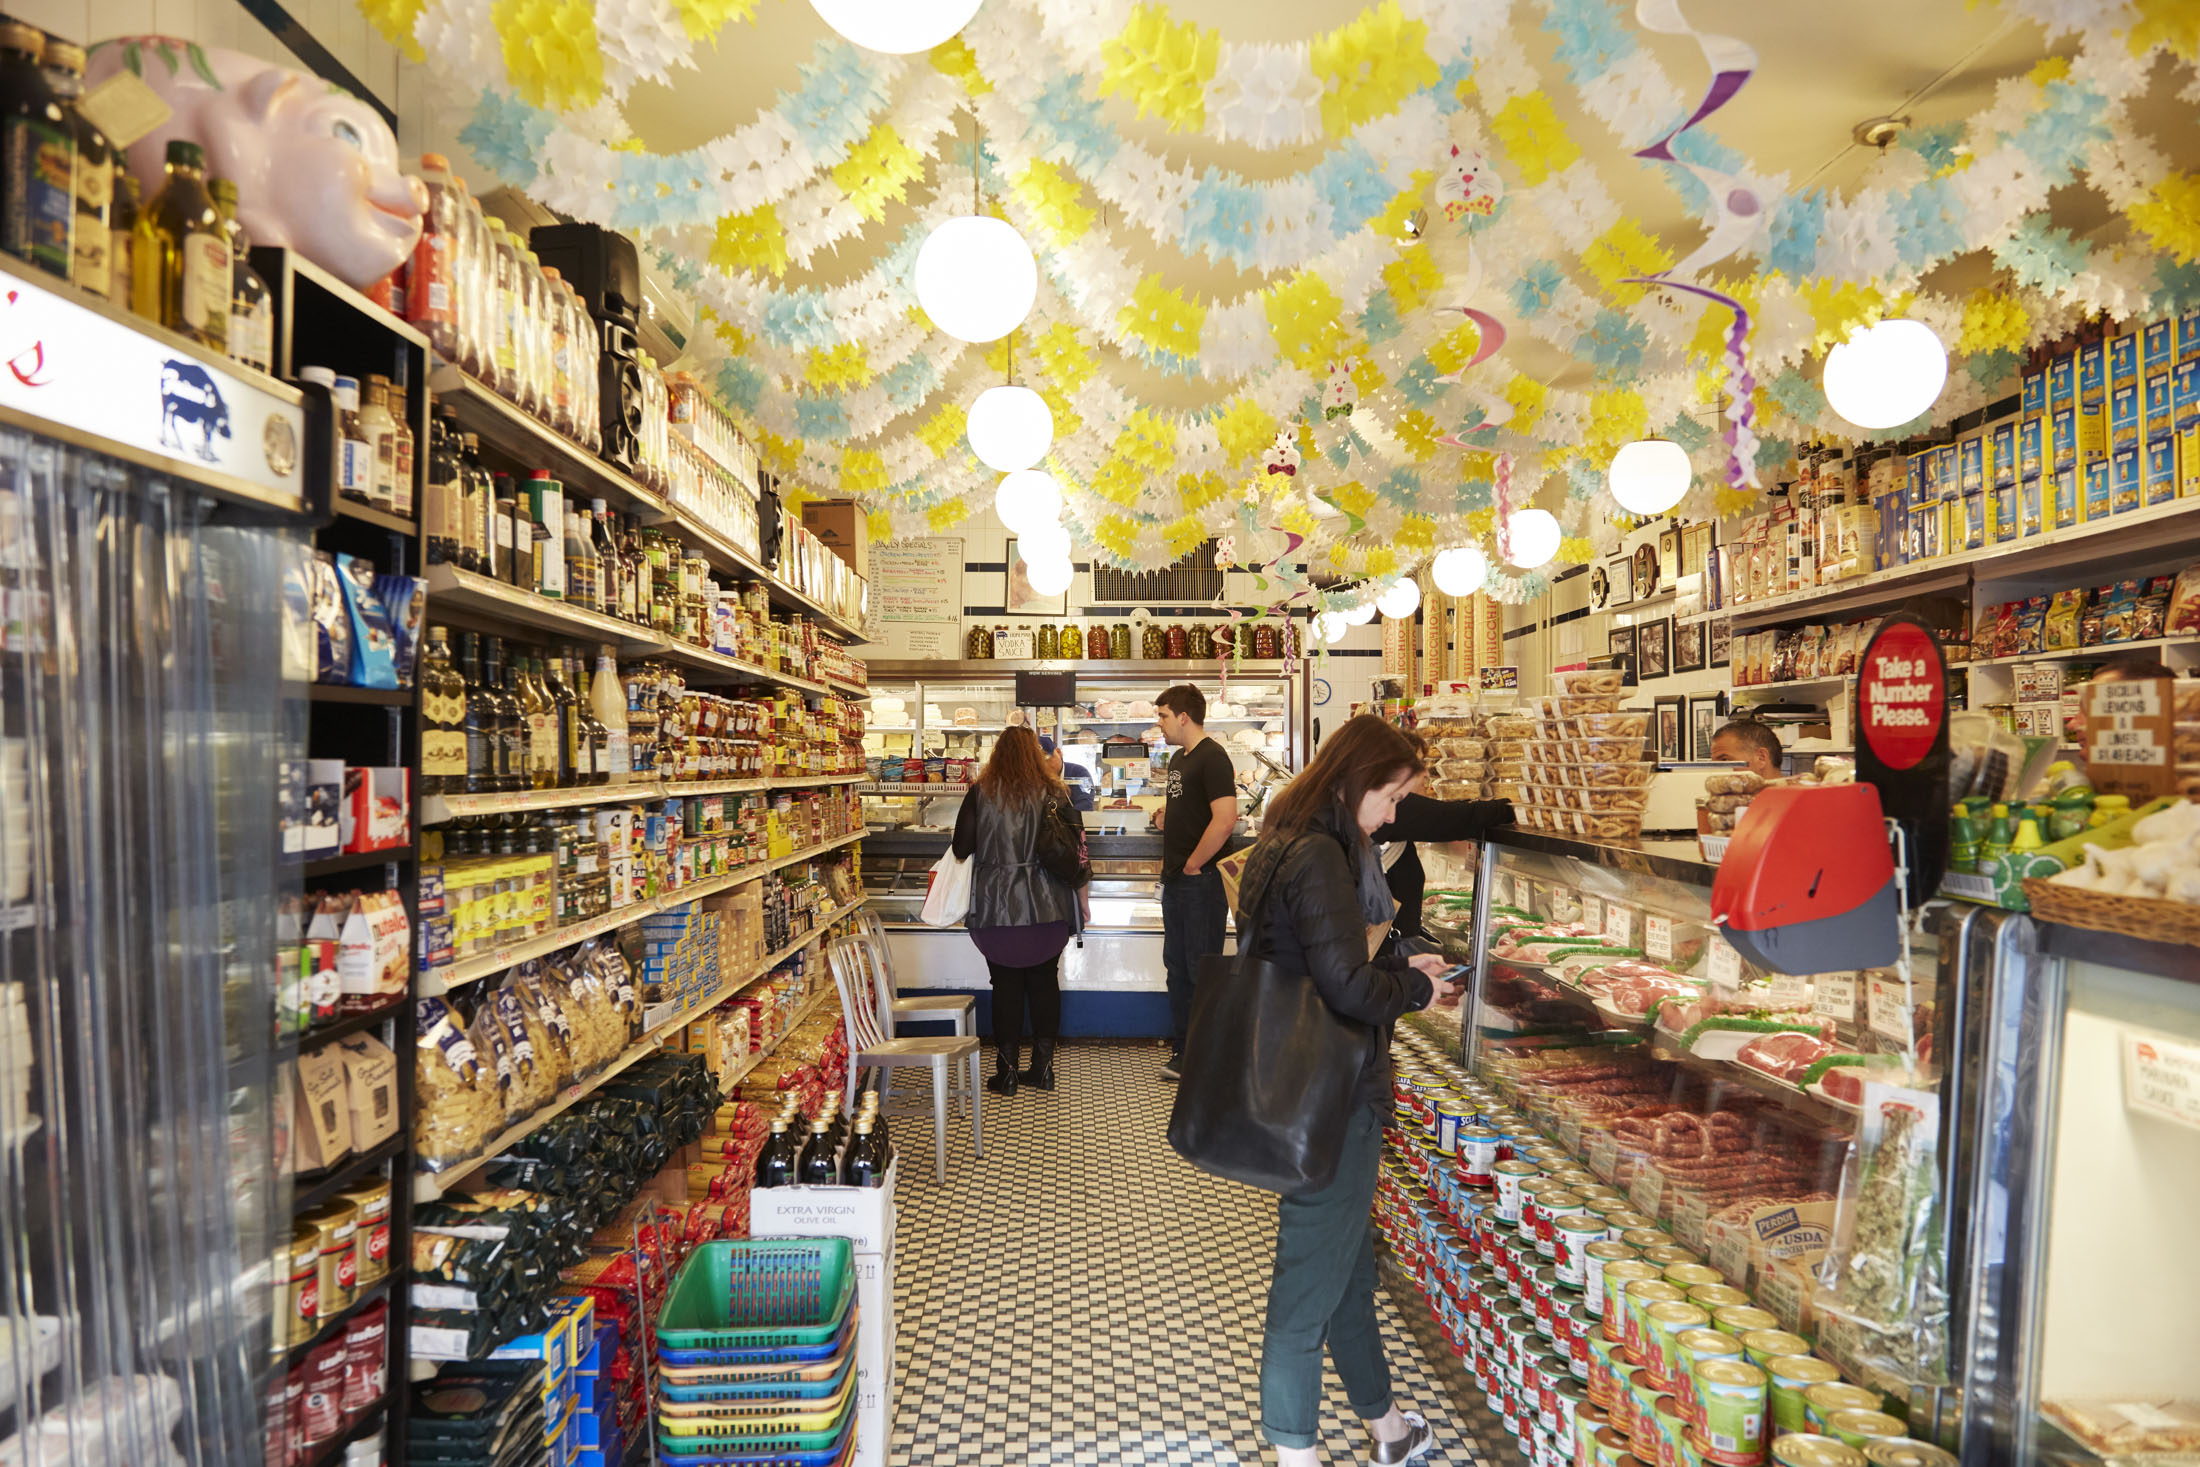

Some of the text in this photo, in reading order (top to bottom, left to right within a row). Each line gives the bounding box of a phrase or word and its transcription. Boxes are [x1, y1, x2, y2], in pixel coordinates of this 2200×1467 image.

[901, 541, 934, 549] SPECIALS
[998, 640, 1025, 648] VODKA
[998, 648, 1024, 656] SAUCE
[1429, 616, 1439, 686] AURICCHIO
[1876, 656, 1926, 679] Take a
[1869, 679, 1933, 703] Number
[1871, 704, 1930, 726] Please.
[777, 1206, 855, 1215] EXTRA VIRGIN
[1758, 1212, 1795, 1231] PERDUE
[1784, 1232, 1824, 1245] USDA
